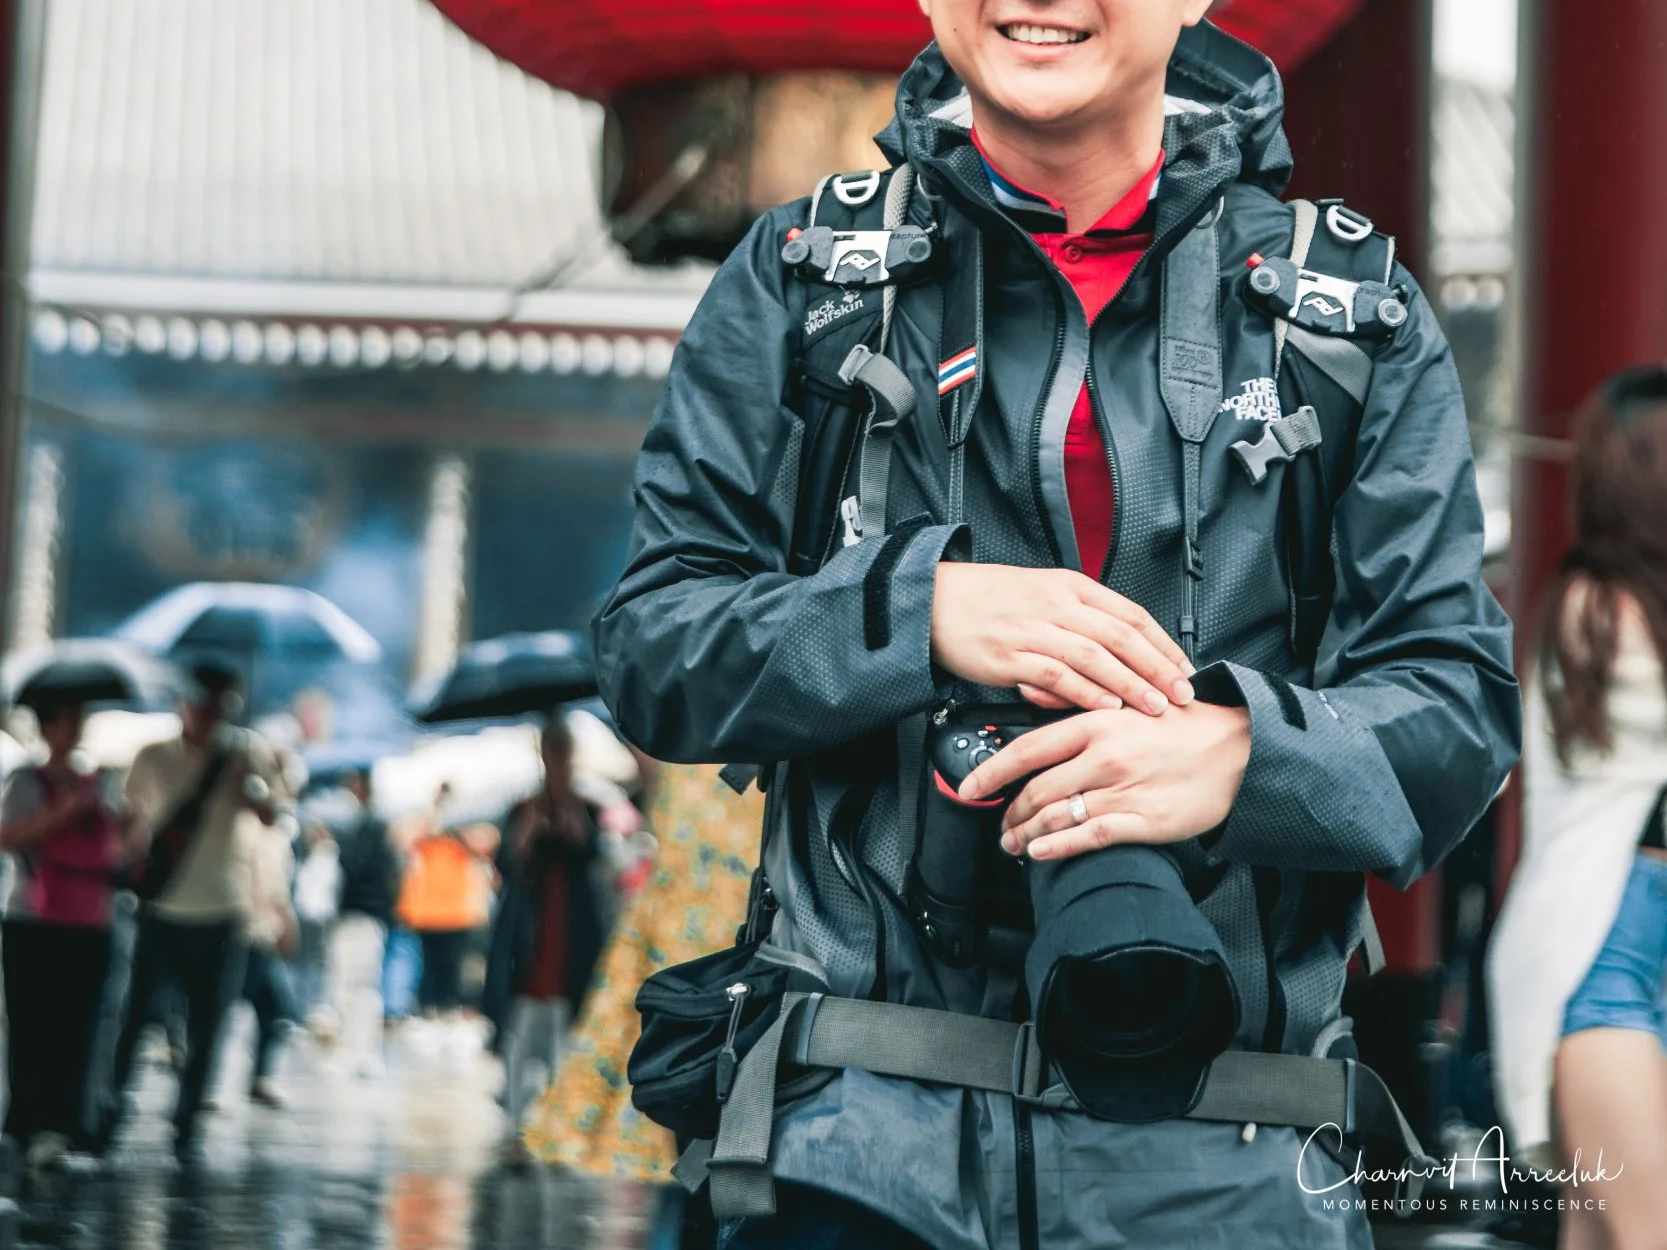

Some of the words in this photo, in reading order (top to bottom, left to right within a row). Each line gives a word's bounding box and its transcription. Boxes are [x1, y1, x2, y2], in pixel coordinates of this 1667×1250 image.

[805, 300, 835, 326] Jack
[805, 299, 864, 335] Wolfskin
[1241, 377, 1276, 393] THE
[1219, 391, 1280, 413] NORTH
[1235, 405, 1282, 422] FACE
